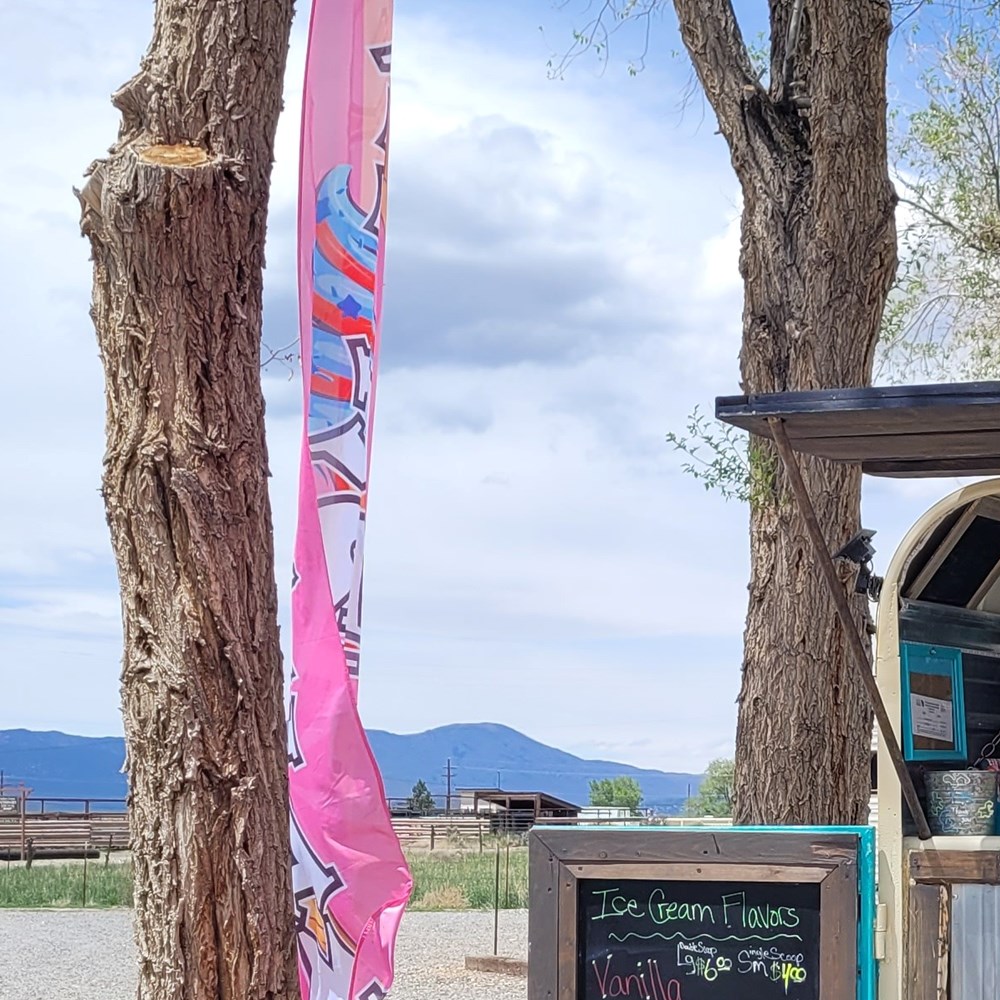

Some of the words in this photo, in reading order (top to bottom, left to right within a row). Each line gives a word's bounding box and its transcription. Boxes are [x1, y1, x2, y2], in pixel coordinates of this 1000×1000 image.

[592, 888, 645, 920] Ice
[649, 889, 715, 924] Cream
[722, 892, 800, 928] Flavors
